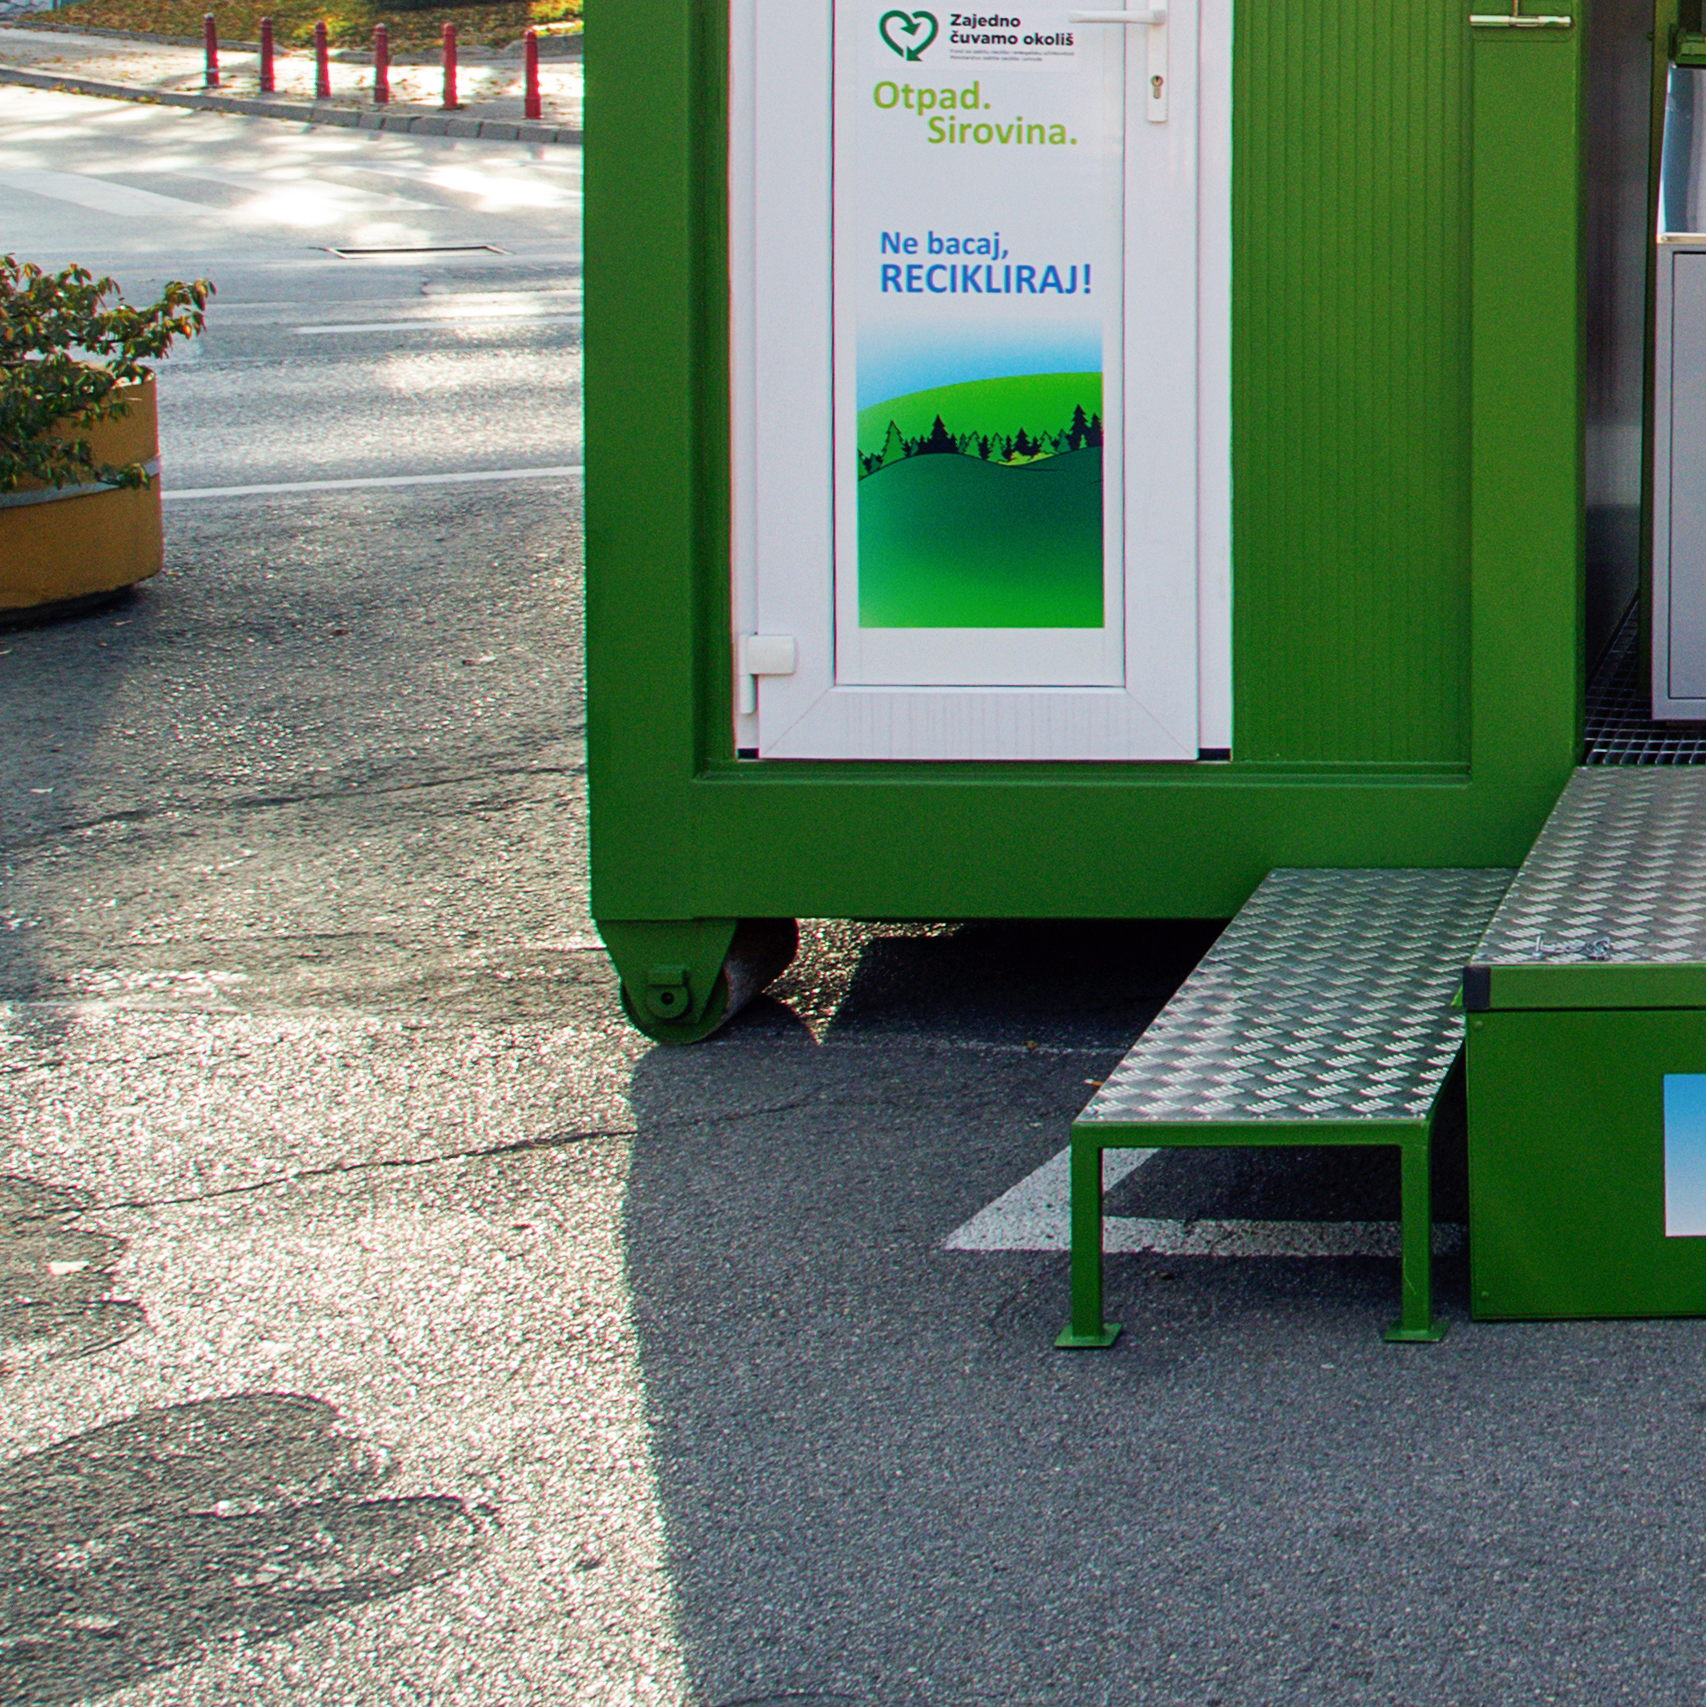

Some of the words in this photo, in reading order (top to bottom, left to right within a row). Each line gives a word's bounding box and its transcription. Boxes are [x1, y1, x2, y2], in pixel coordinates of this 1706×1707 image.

[950, 14, 1021, 29] Zajedno
[950, 31, 1018, 44] čuvamo
[1023, 32, 1074, 46] okoliš
[874, 81, 990, 116] Otpad.
[929, 116, 1076, 145] Sirovina.
[881, 232, 917, 255] Ne
[927, 231, 1007, 261] bacaj,
[881, 264, 1090, 294] RECIKLIRAJ!
